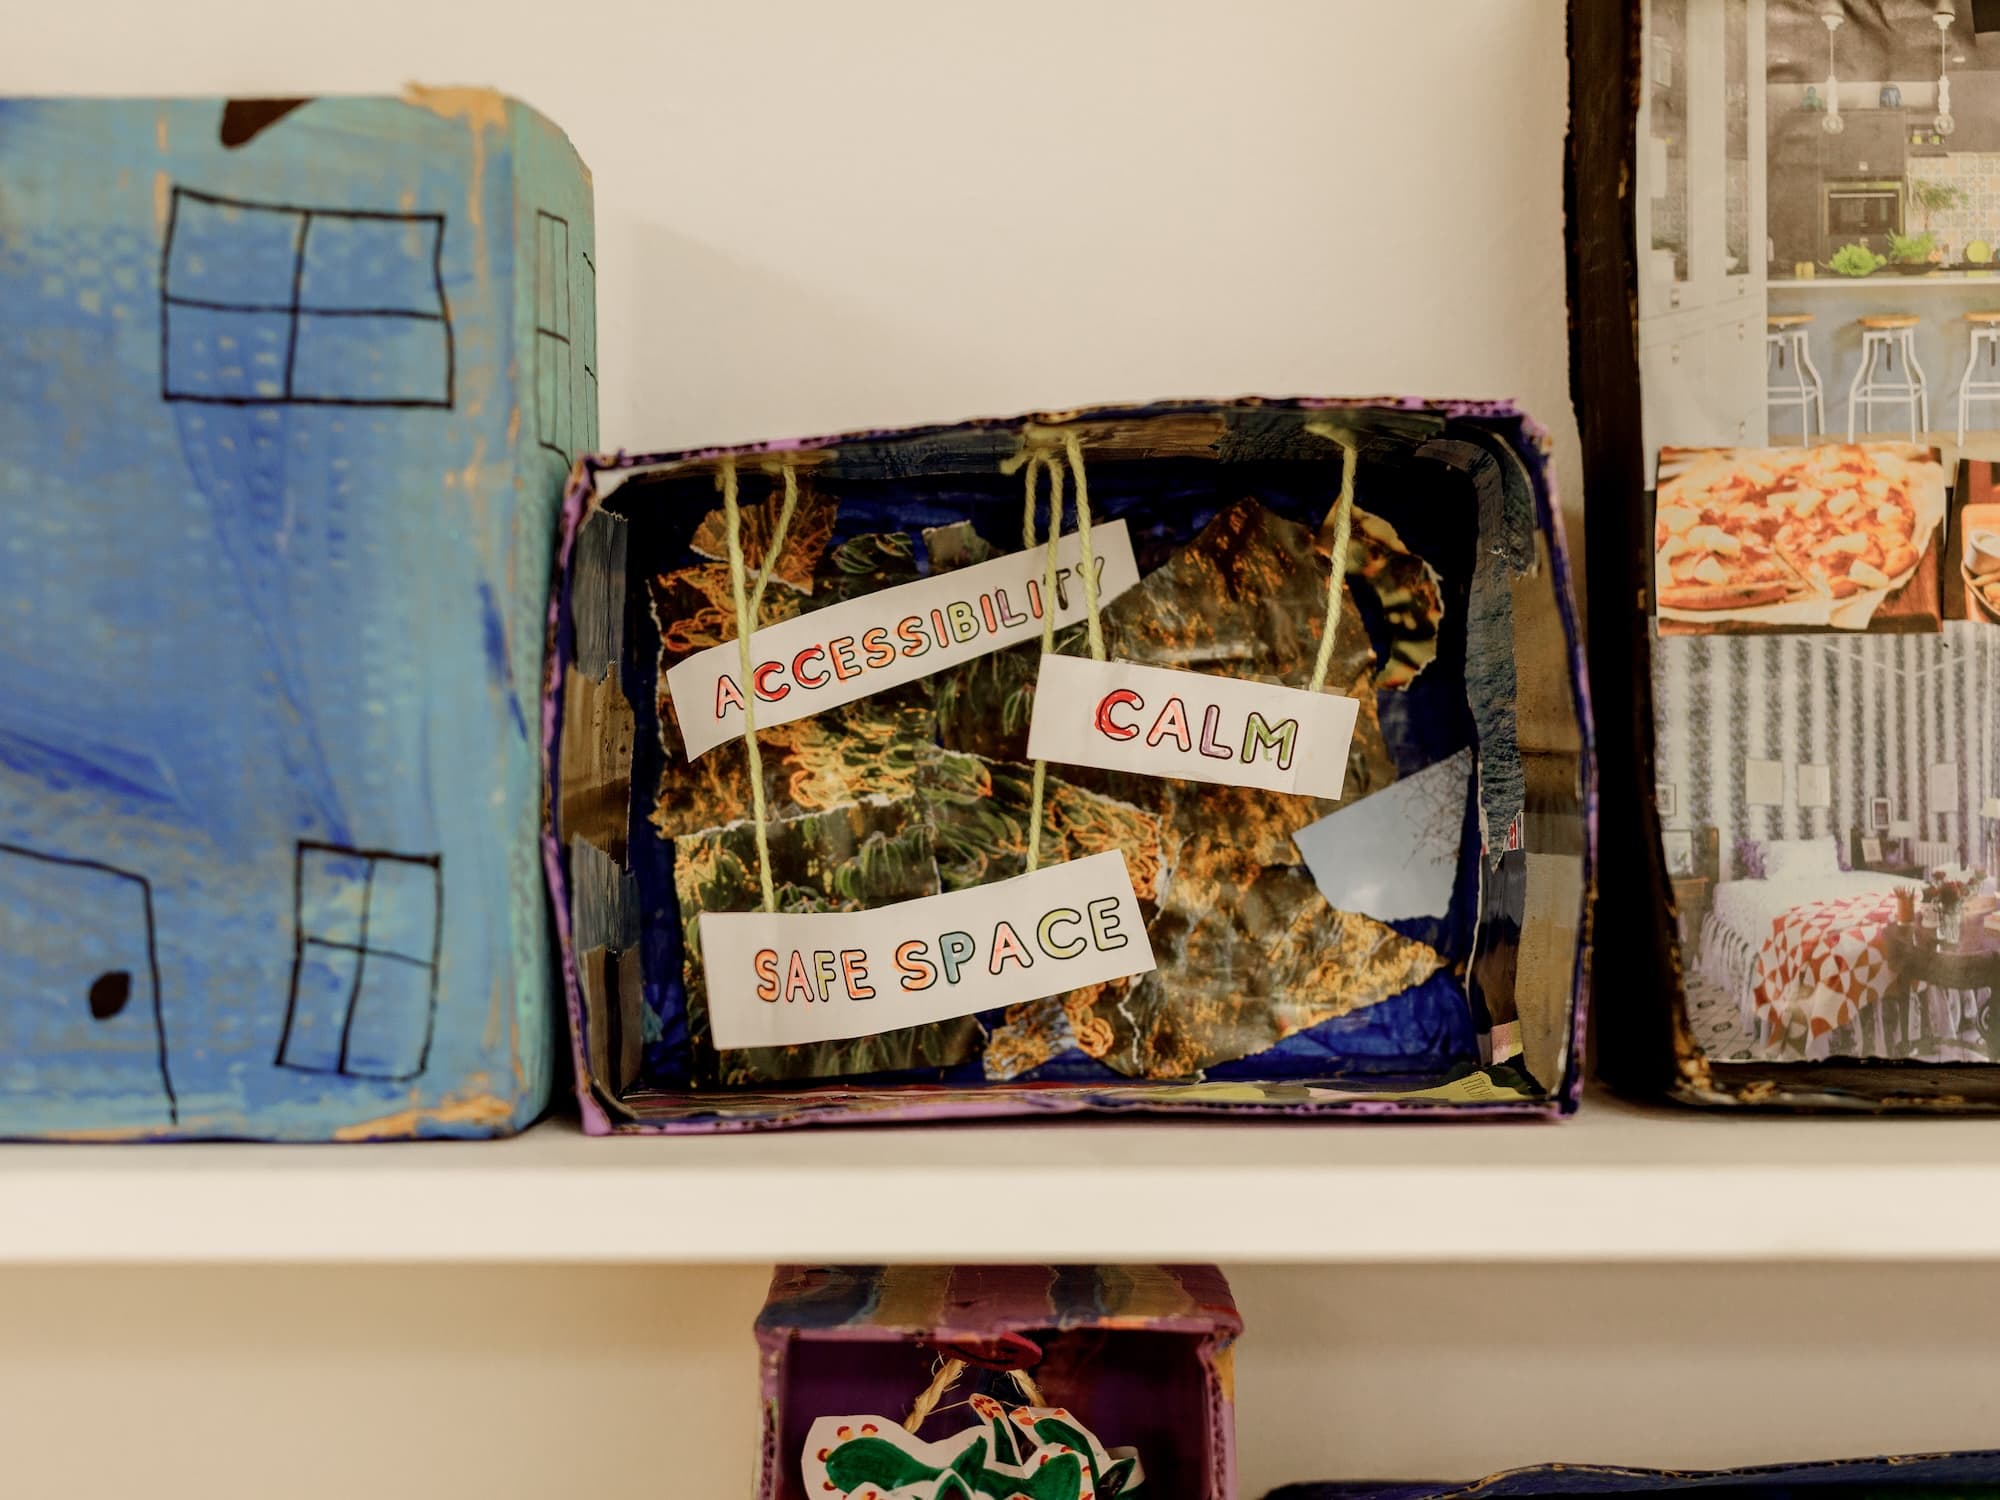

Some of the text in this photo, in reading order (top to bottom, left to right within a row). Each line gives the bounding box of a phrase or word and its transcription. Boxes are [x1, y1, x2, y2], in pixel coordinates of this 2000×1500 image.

[714, 556, 1105, 719] ACCESSIBILITY
[1095, 688, 1299, 771] CALM
[755, 896, 1128, 1004] SAFE SPACE
